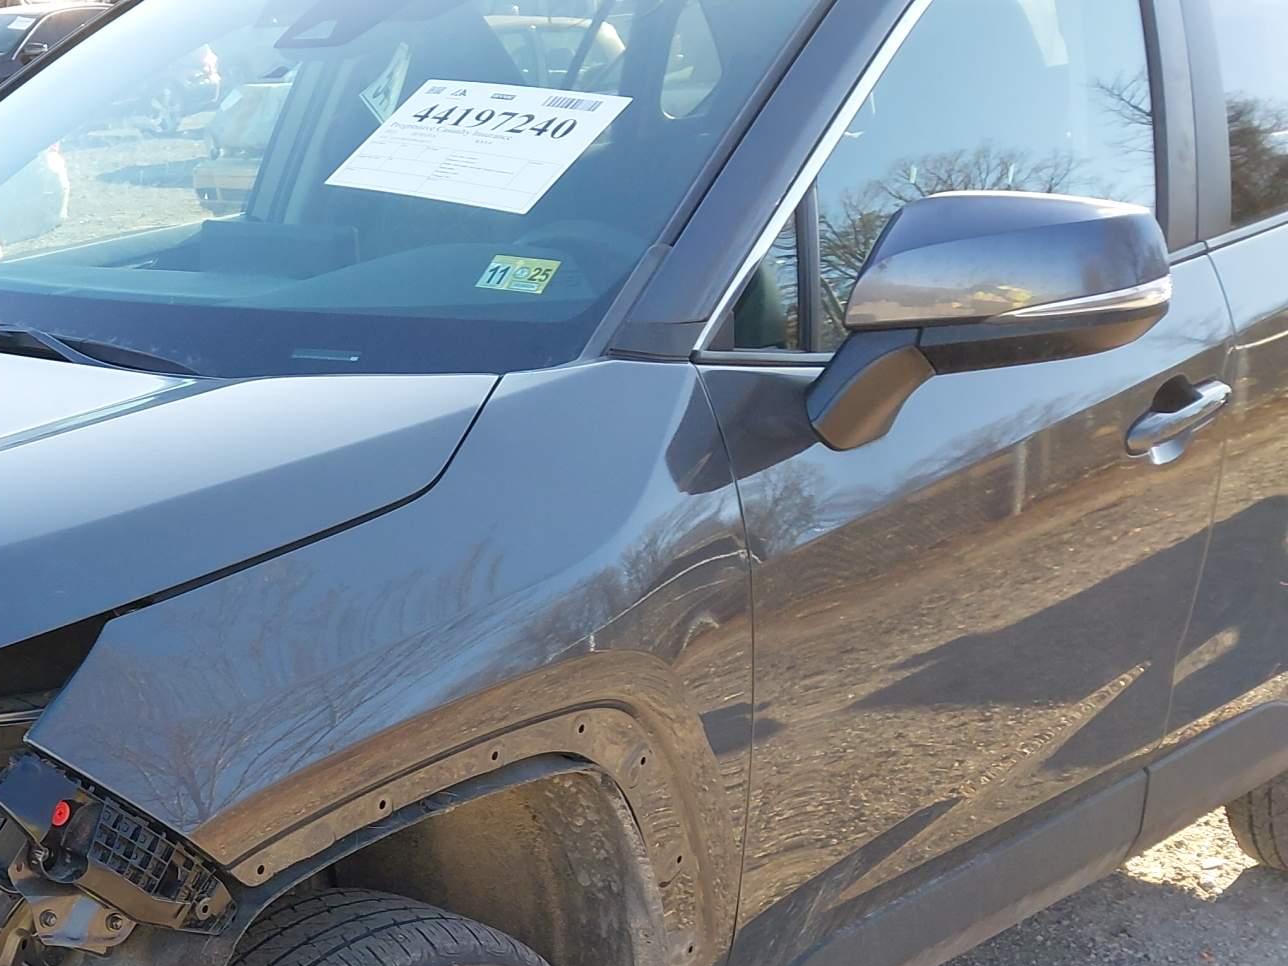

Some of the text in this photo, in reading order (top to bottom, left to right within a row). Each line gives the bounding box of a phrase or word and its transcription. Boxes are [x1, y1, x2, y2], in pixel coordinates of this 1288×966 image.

[413, 103, 578, 139] 44197240
[486, 265, 552, 285] 11 25
